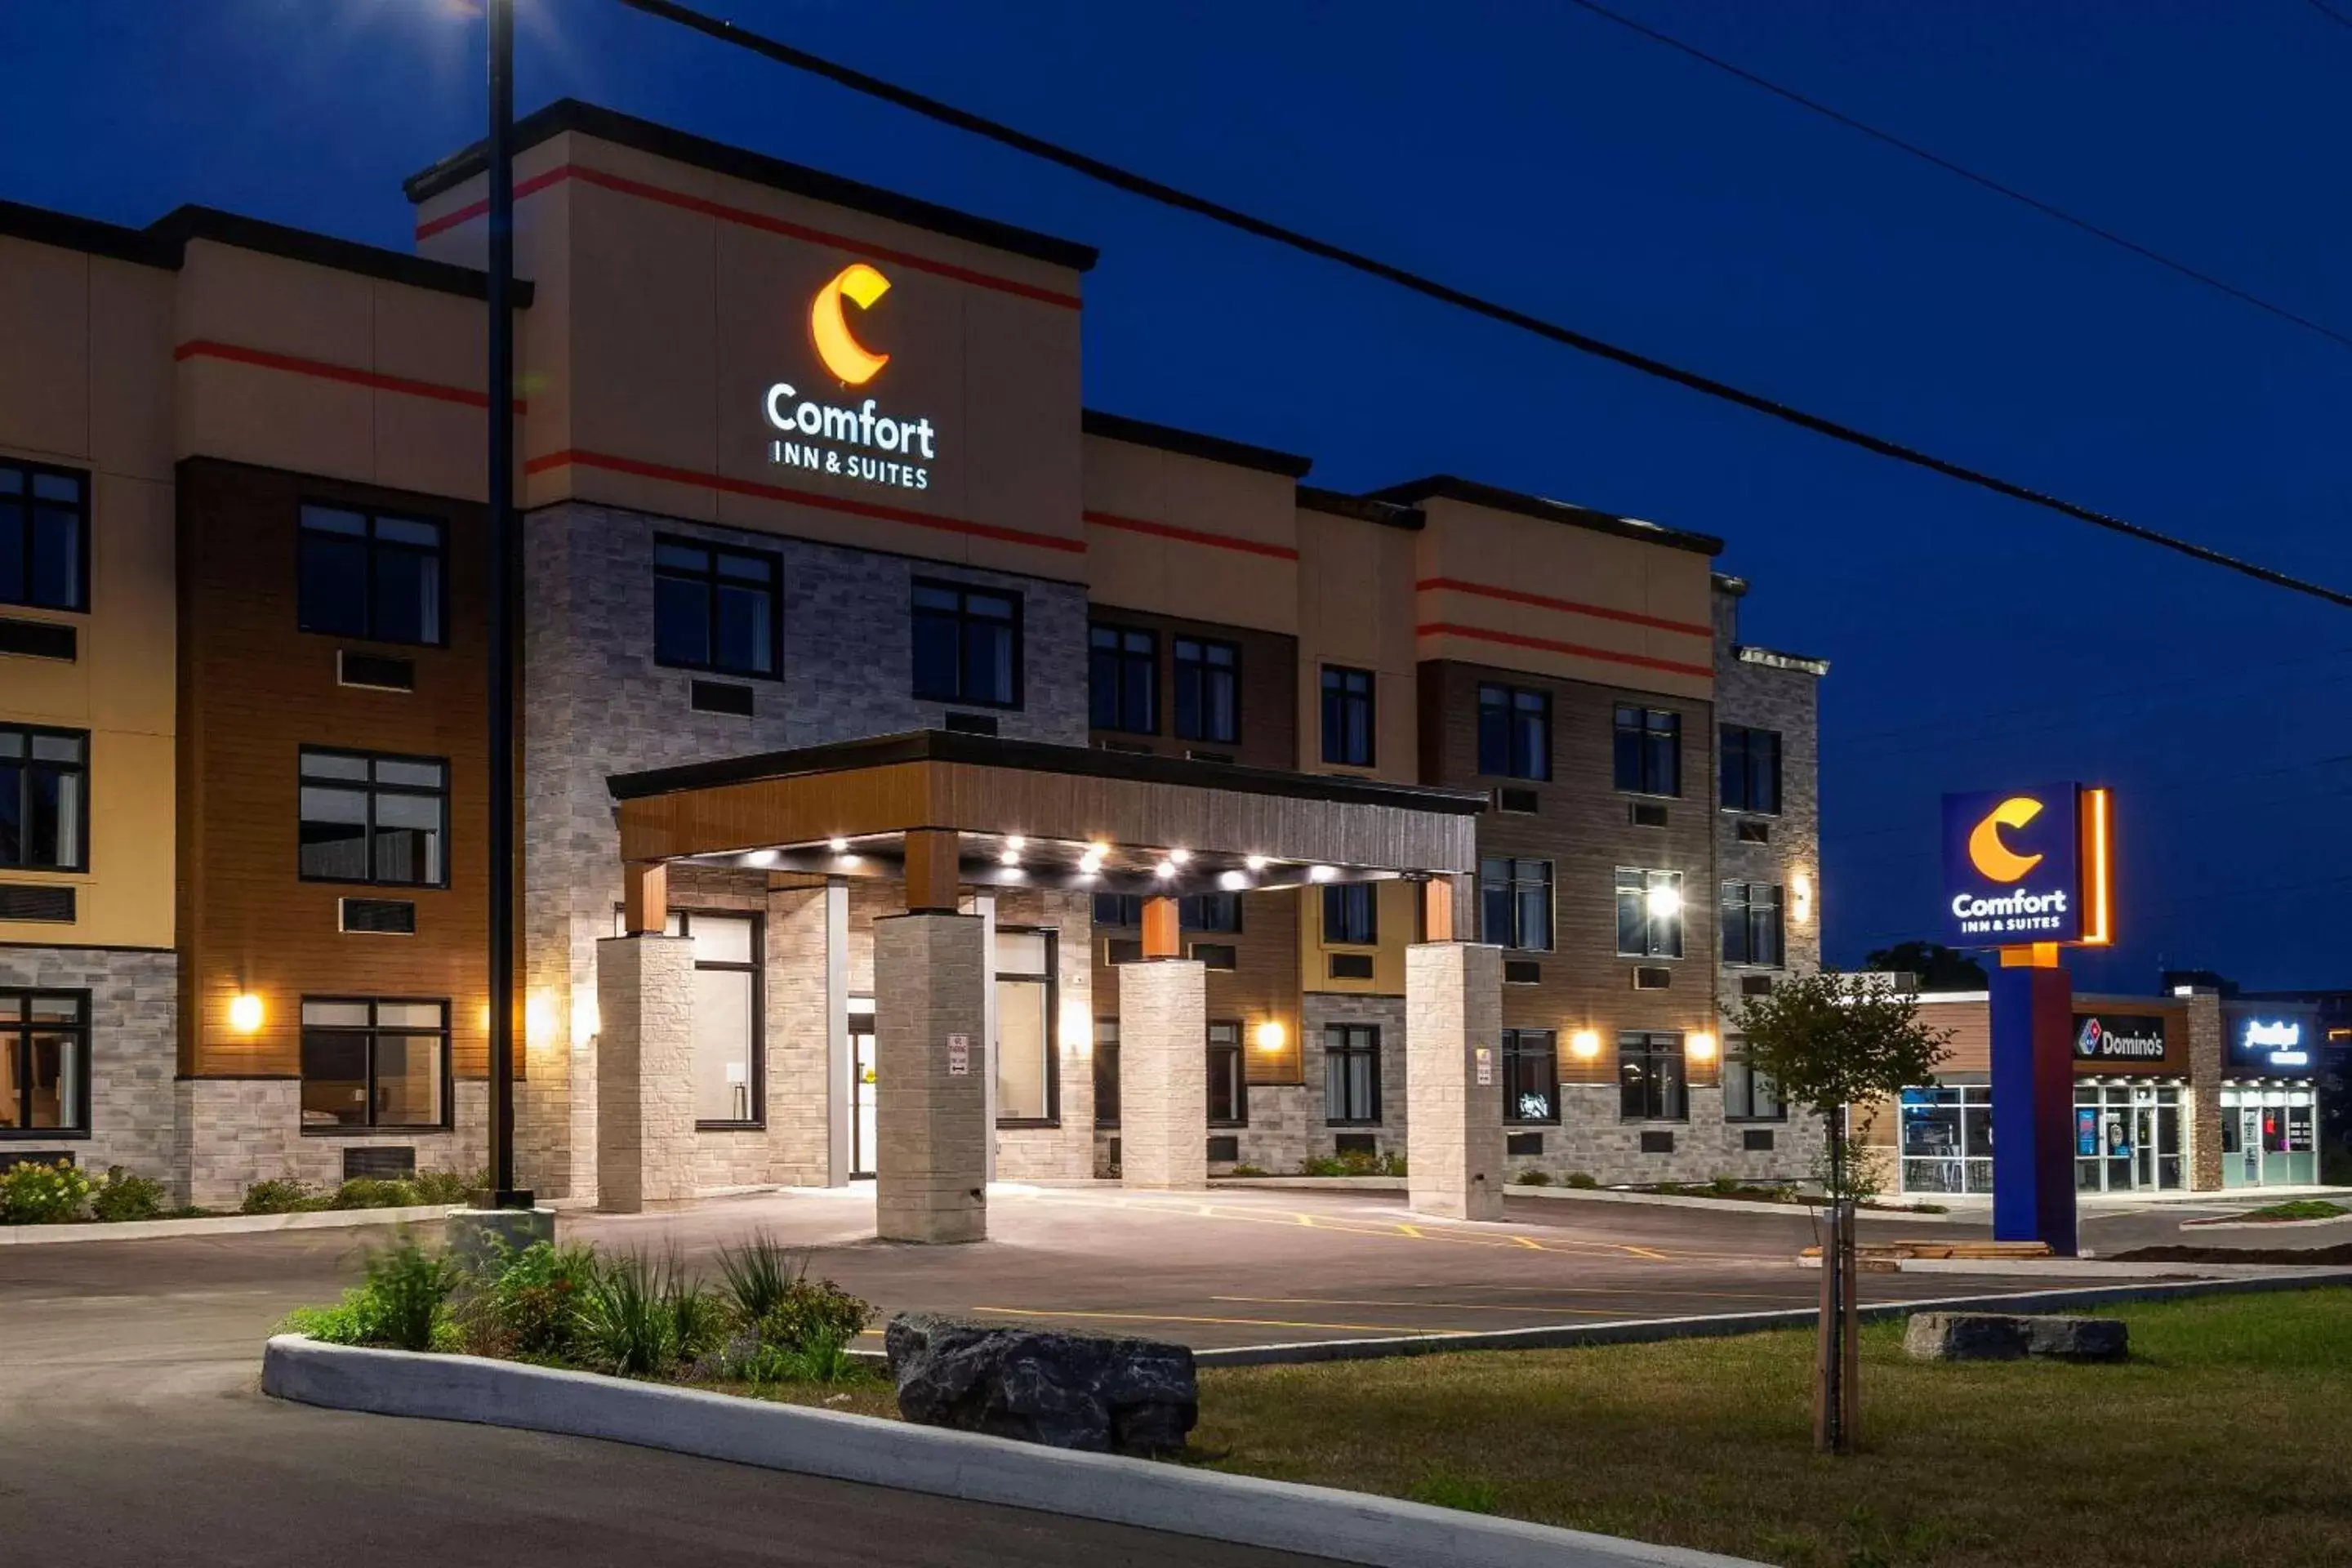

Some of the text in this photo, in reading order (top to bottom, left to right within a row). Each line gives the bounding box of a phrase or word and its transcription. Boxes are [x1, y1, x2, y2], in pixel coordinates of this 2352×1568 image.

[766, 382, 934, 458] Comfort
[773, 439, 929, 490] INN & SUITES
[1952, 889, 2067, 918] Comfort
[1962, 915, 2060, 933] INN & SUITES
[2102, 1030, 2163, 1056] Domino's
